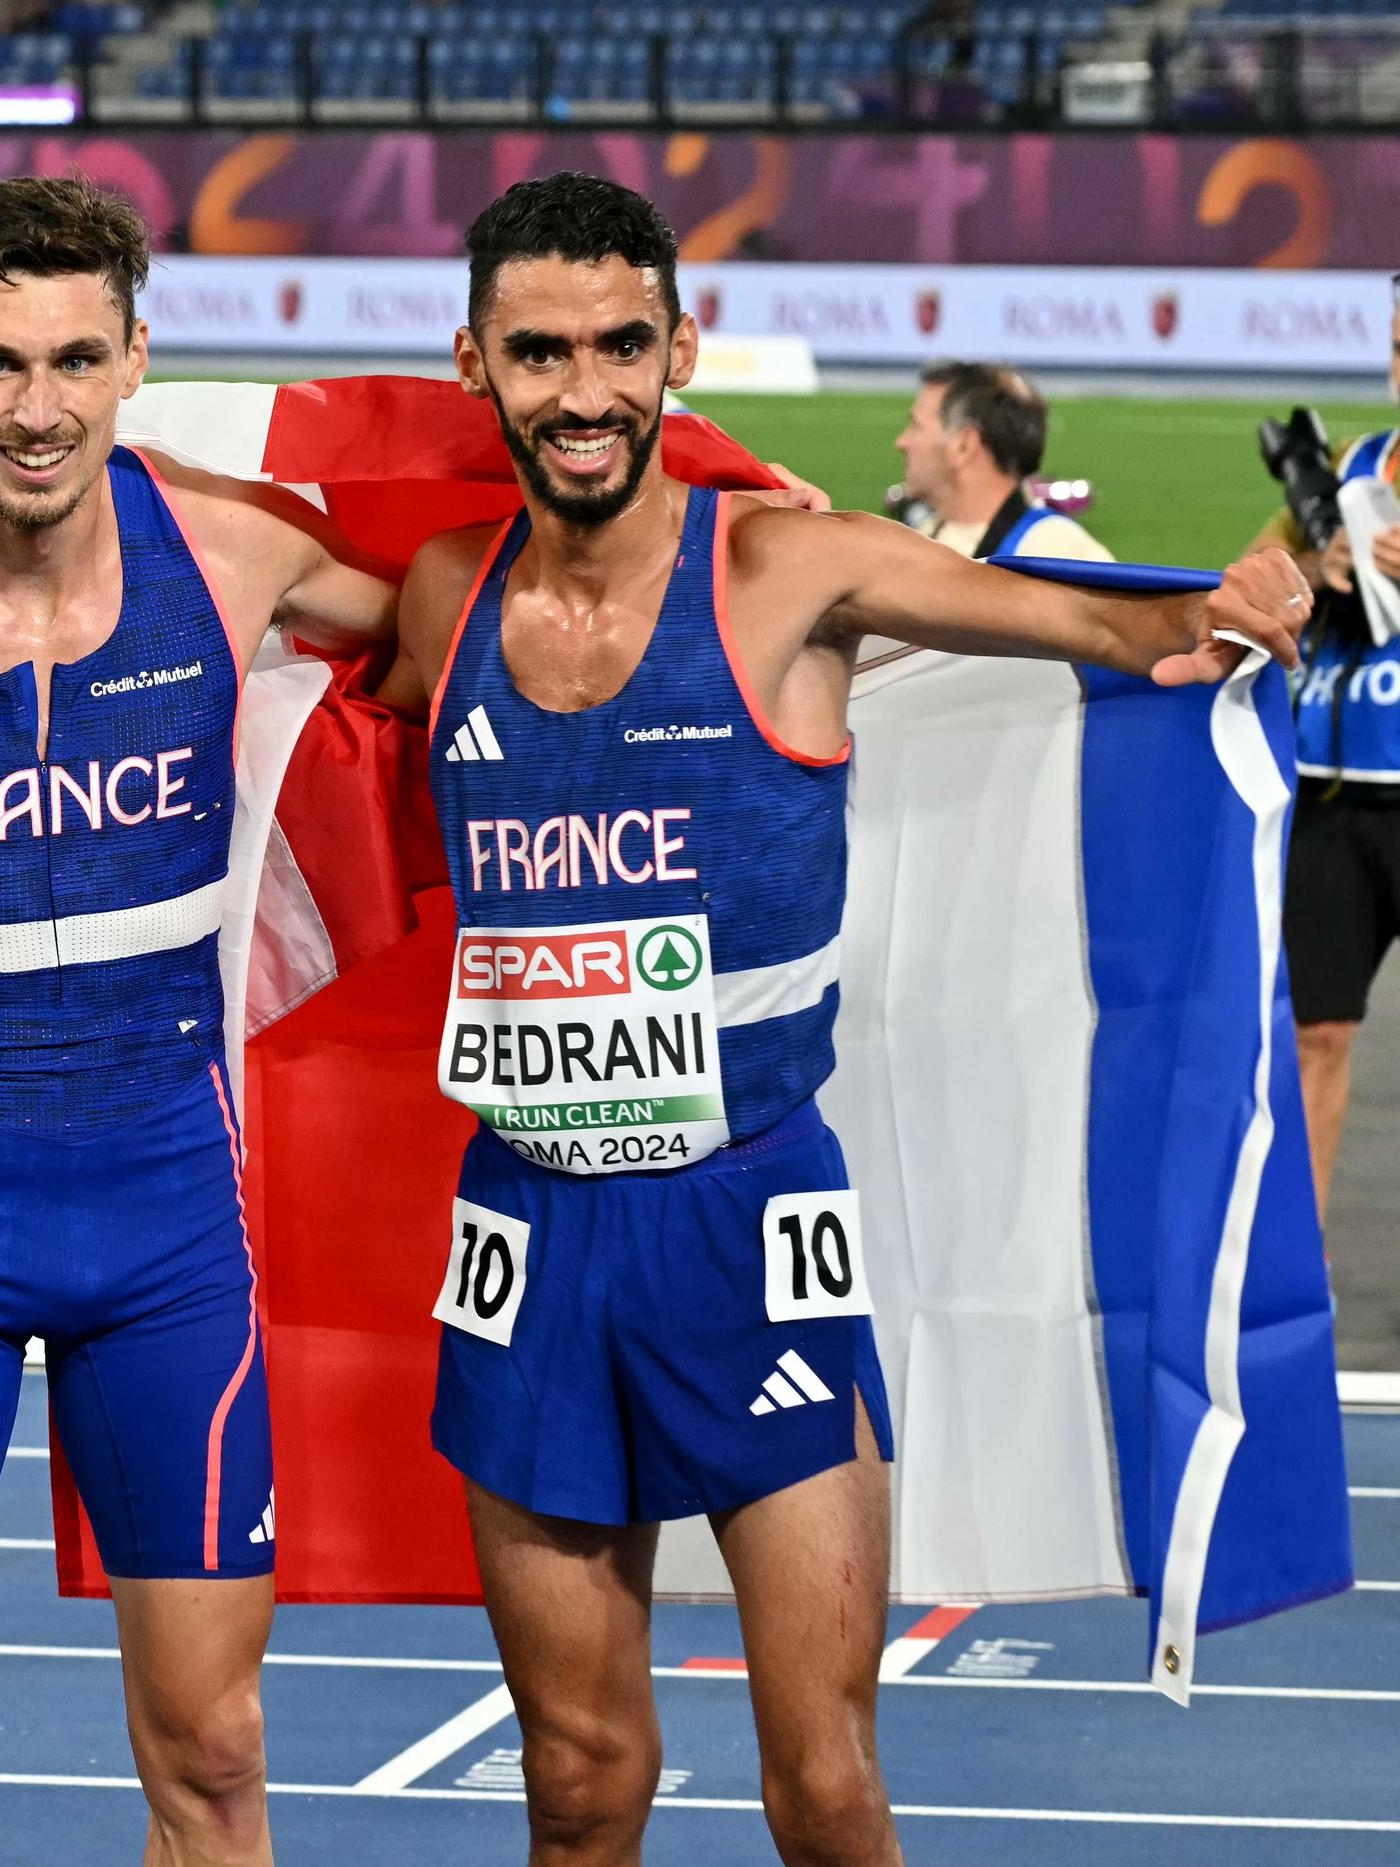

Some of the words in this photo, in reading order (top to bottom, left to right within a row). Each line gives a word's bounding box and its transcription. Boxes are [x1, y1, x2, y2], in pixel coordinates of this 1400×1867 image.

[90, 676, 136, 697] Crédit
[153, 661, 203, 685] Mutuel
[624, 727, 666, 743] Crédit
[682, 724, 732, 740] Mutuel
[467, 808, 698, 892] FRANCE
[463, 940, 625, 991] SPAR
[448, 1012, 706, 1087] BEDRANI
[505, 1107, 561, 1129] RUN
[509, 1138, 592, 1167] OMA
[600, 1133, 691, 1166] 2024
[456, 1222, 515, 1320] 10
[778, 1210, 853, 1301] 10
